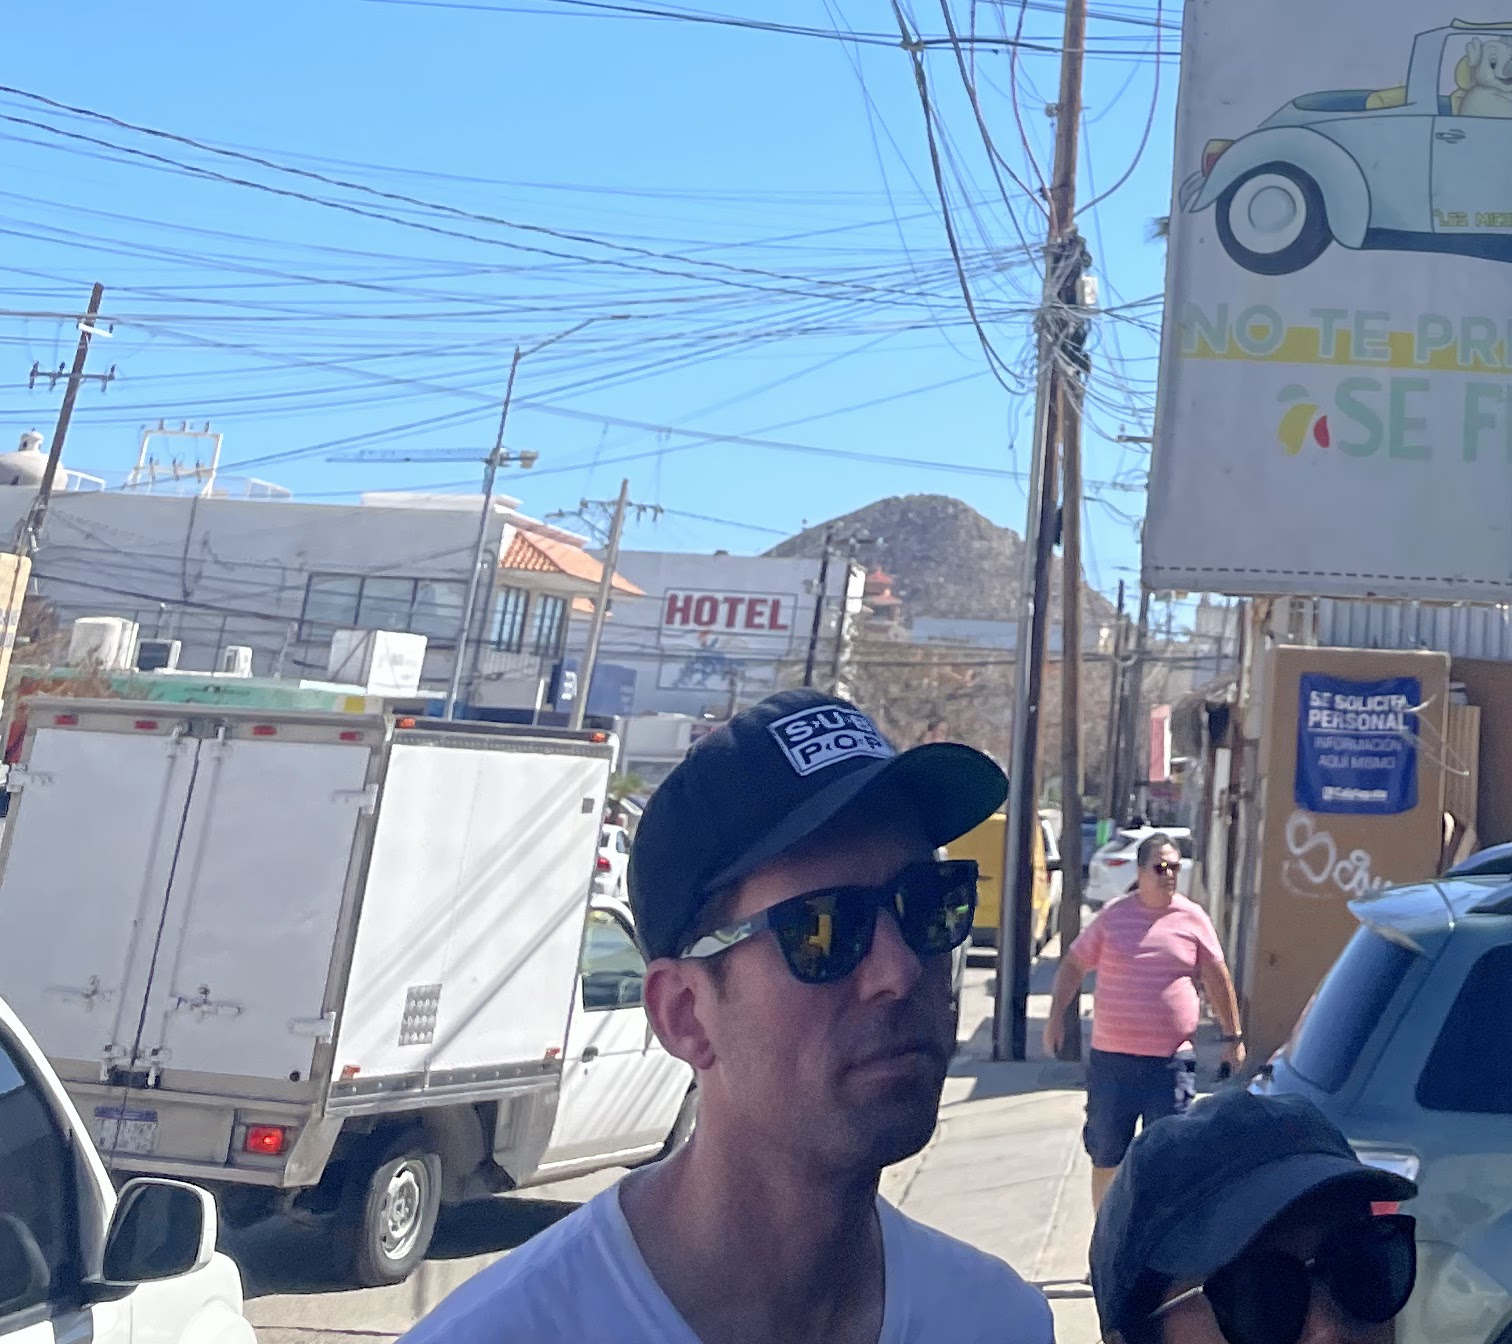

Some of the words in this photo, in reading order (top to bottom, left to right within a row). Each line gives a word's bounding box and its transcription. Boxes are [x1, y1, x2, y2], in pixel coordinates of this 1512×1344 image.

[1184, 303, 1285, 356] NO
[1308, 308, 1392, 361] TE
[1333, 376, 1432, 461] SE
[665, 593, 789, 631] HOTEL
[1309, 690, 1333, 707] SE
[1308, 710, 1409, 730] PERSONAL
